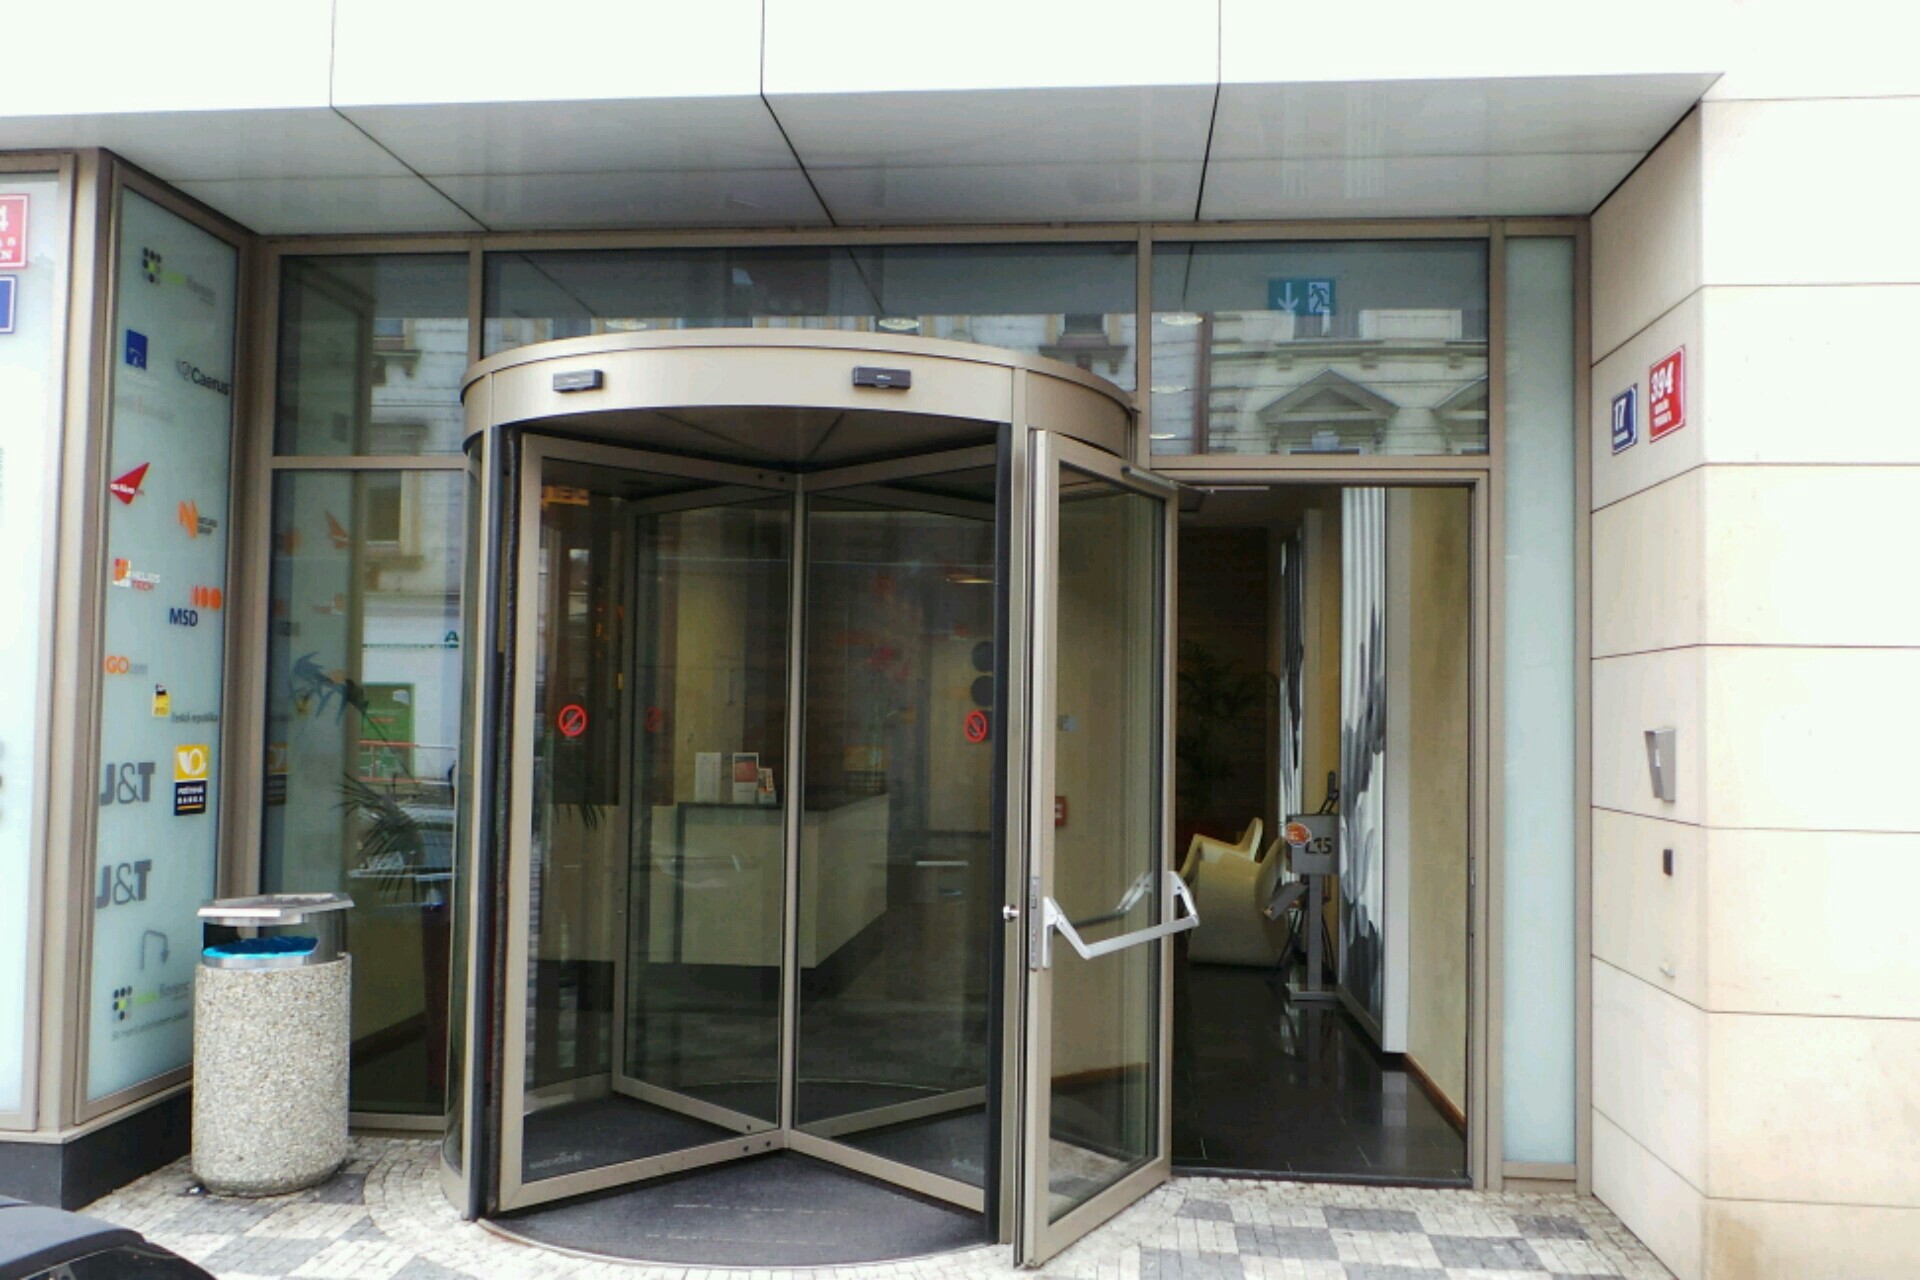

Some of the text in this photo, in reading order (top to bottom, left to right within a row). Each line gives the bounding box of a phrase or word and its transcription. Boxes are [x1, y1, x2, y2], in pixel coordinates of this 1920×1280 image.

[169, 607, 198, 627] MSD
[104, 655, 130, 675] GO
[99, 761, 156, 807] J&T
[96, 859, 153, 909] J&T
